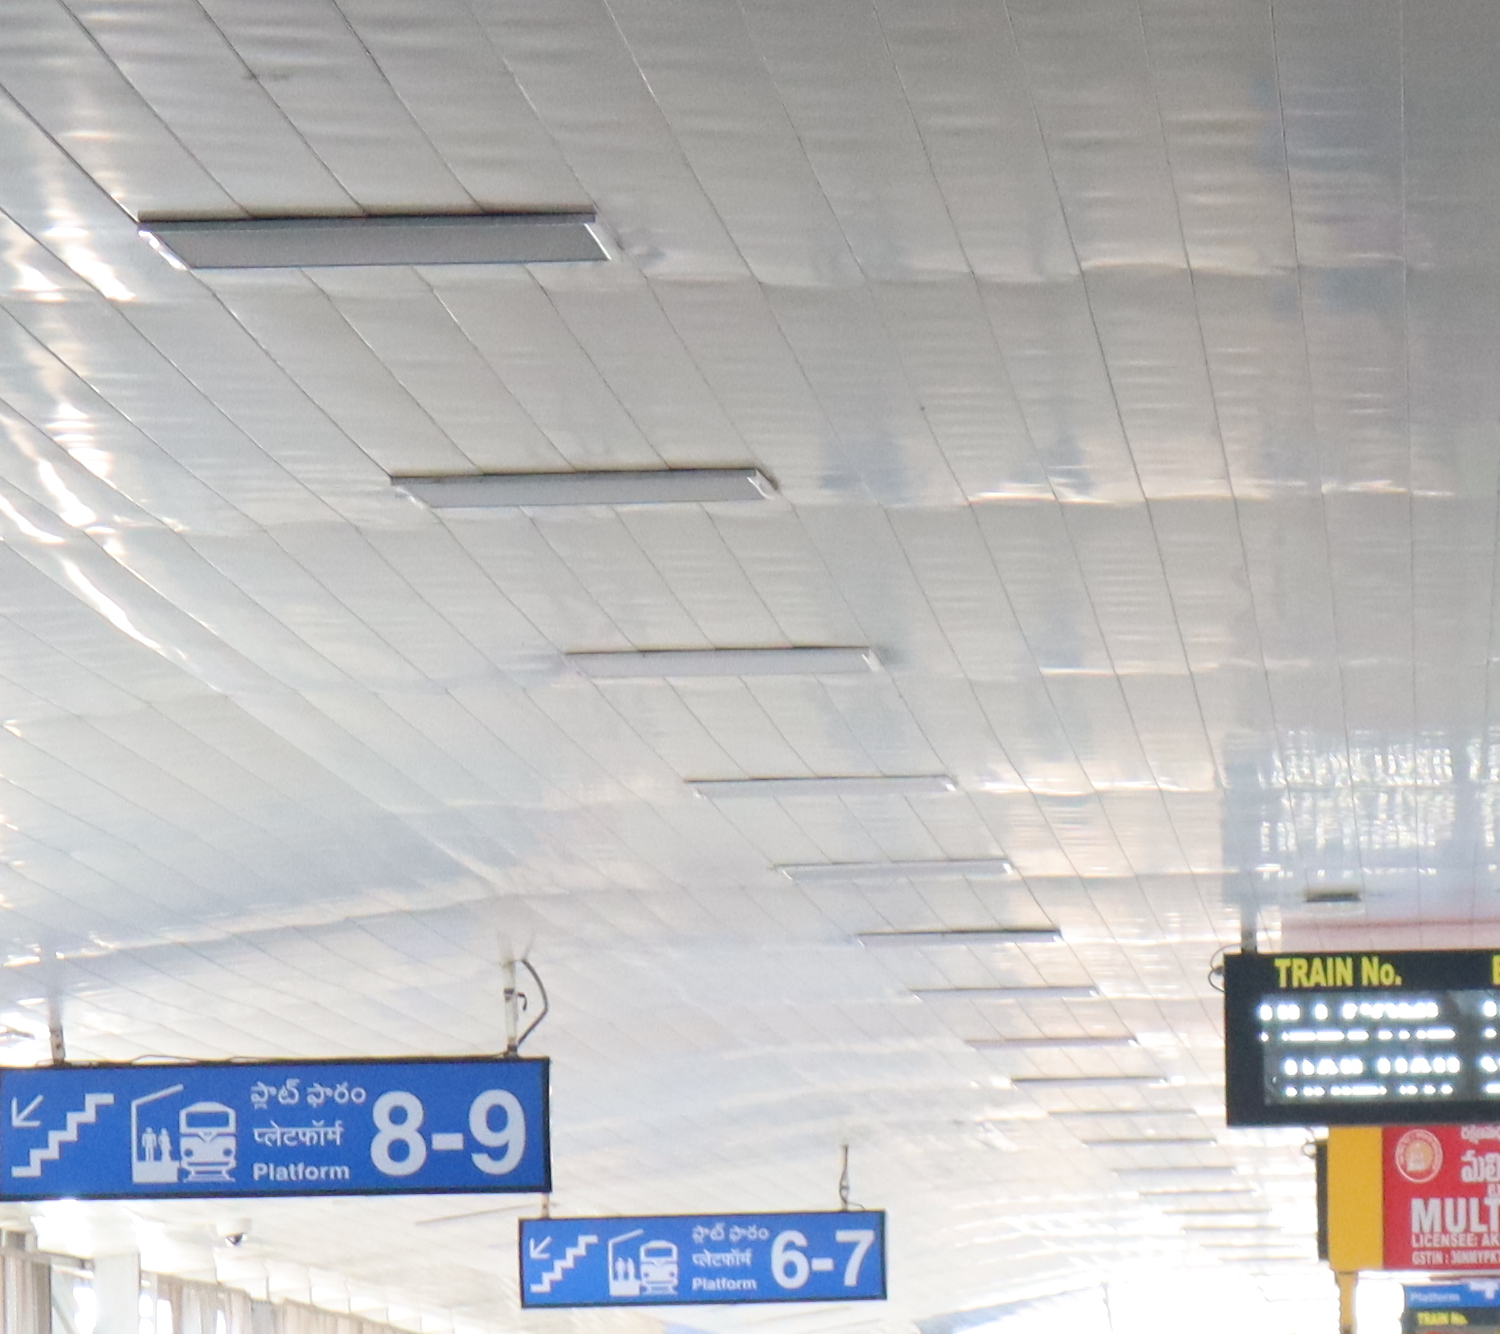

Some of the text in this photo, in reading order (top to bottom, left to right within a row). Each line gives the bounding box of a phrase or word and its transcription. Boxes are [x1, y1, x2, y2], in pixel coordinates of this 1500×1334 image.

[1274, 955, 1403, 988] TRAIN No.
[370, 1089, 527, 1176] 8-9
[252, 1162, 351, 1182] Platform
[771, 1229, 876, 1290] 6-7
[692, 1276, 757, 1291] Platform
